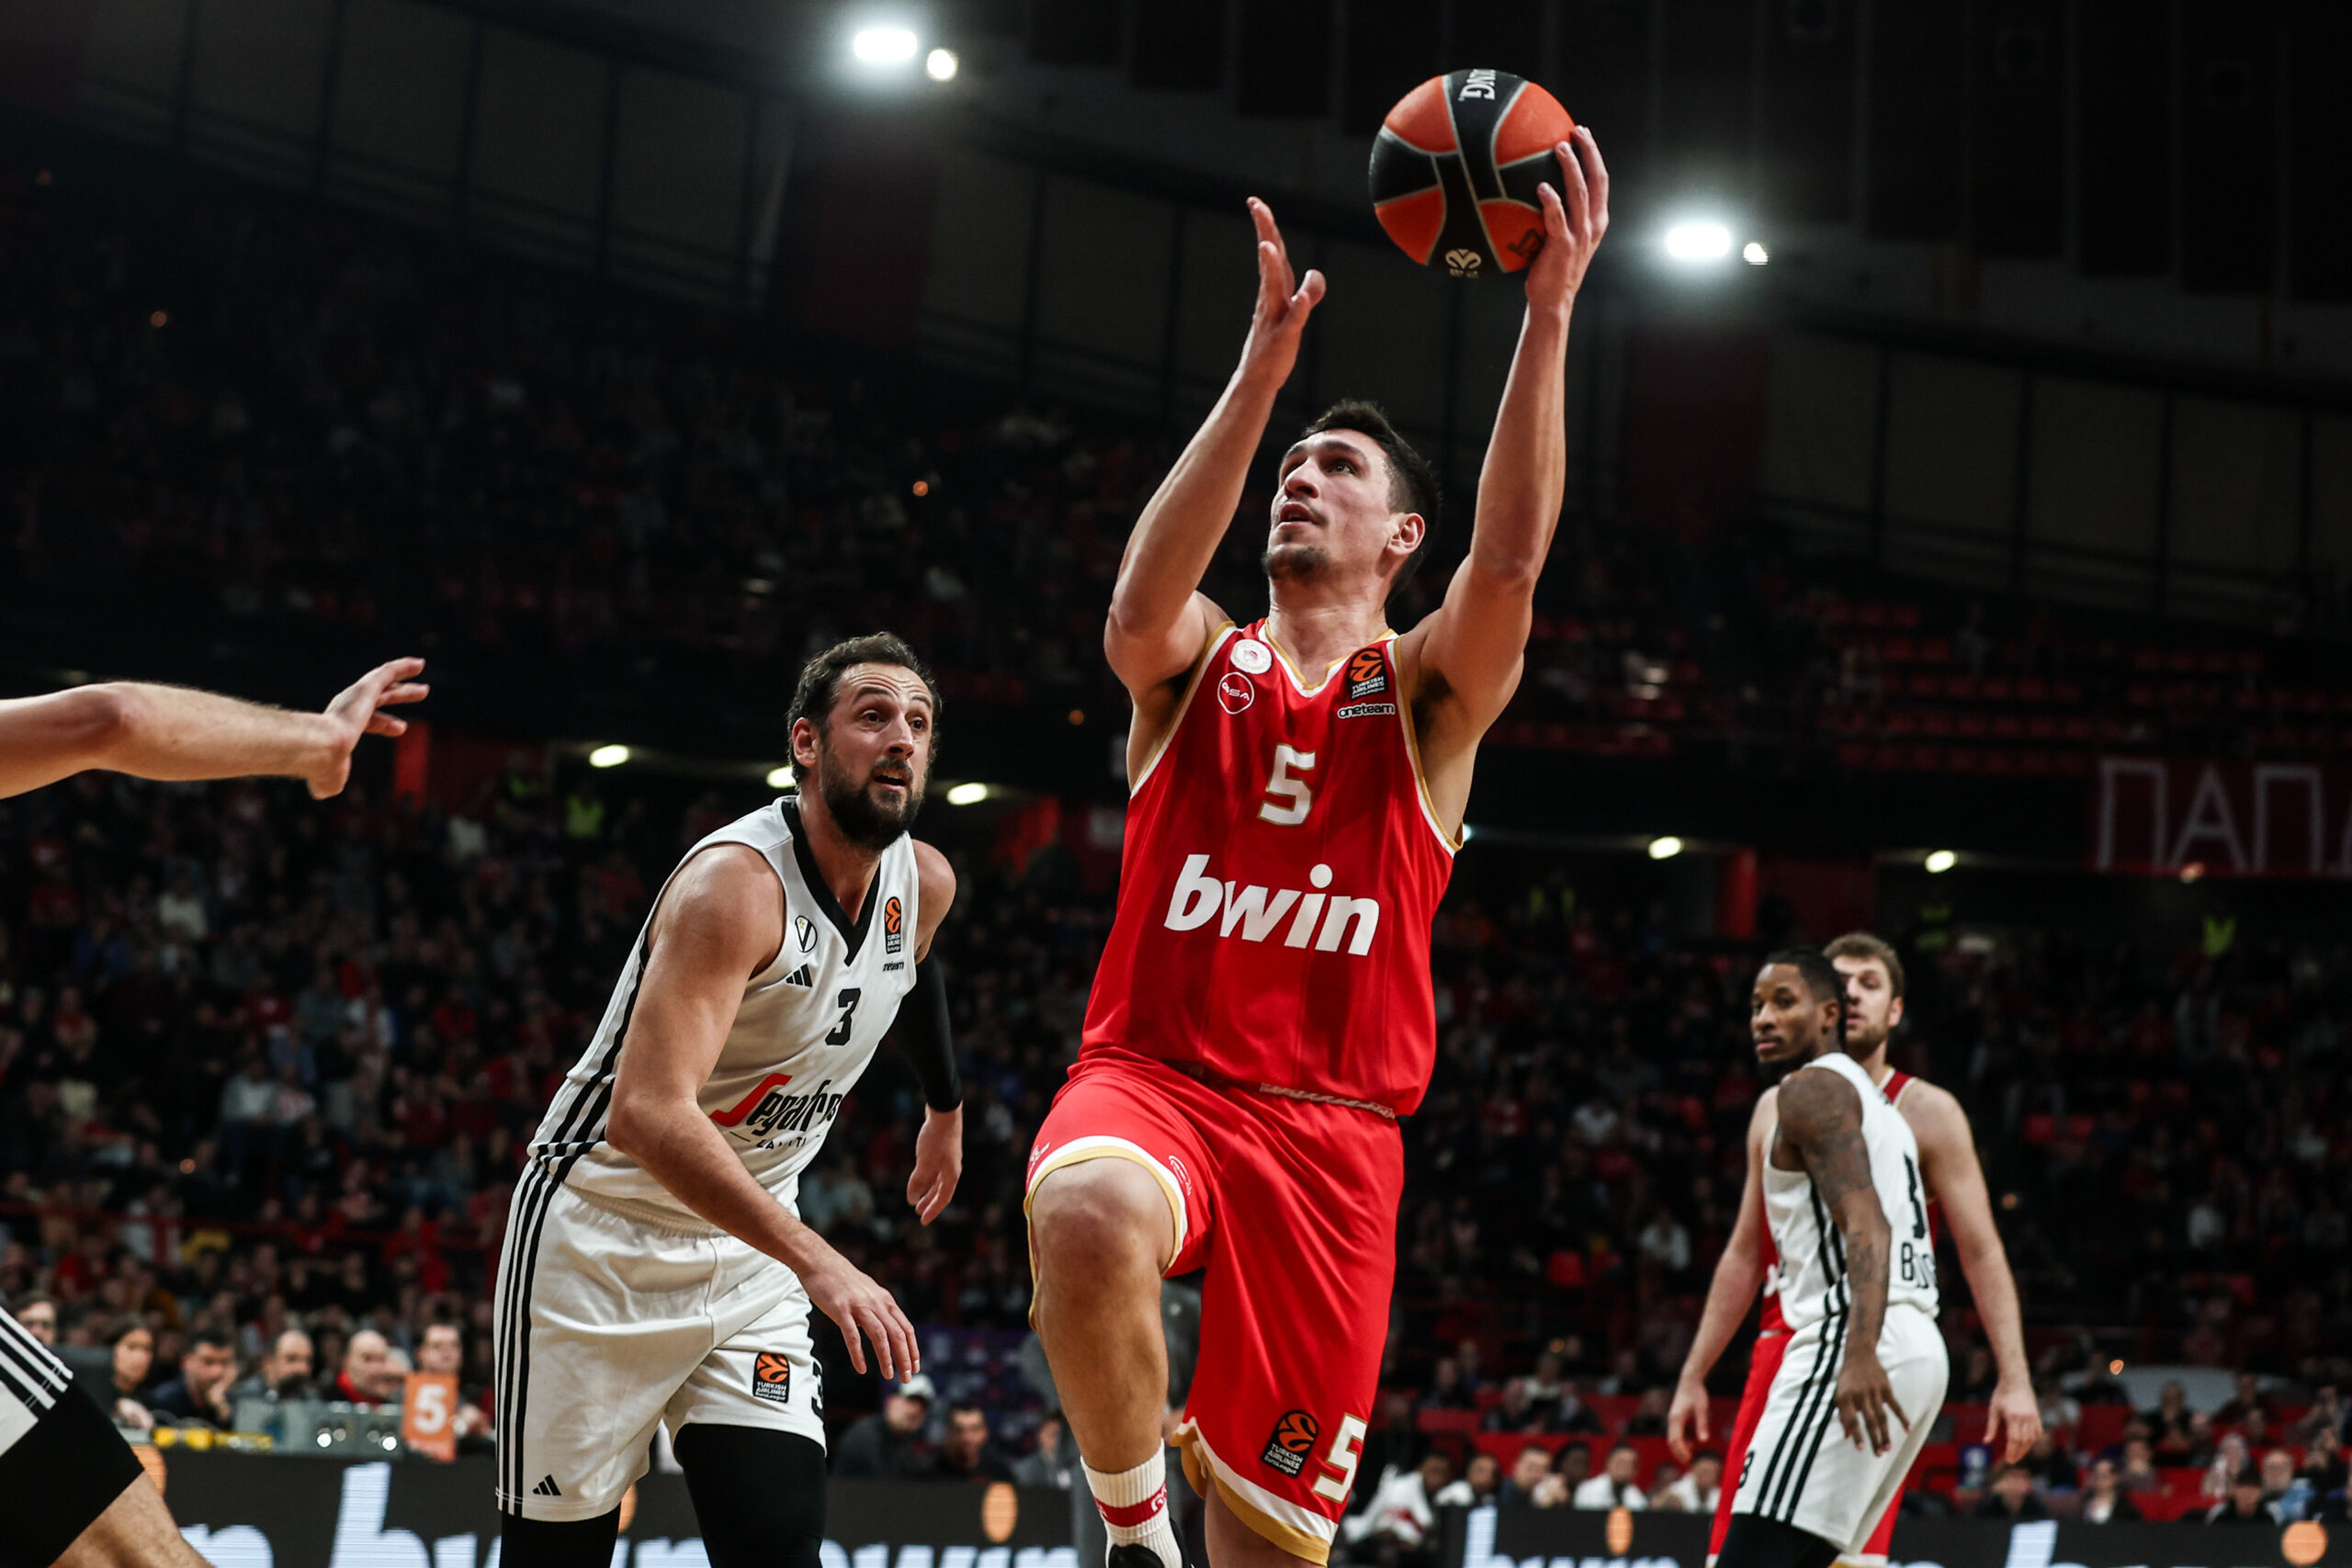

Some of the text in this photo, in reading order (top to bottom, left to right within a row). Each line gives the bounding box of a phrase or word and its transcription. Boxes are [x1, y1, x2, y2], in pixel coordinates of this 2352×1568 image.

[1257, 742, 1316, 826] 5
[2096, 755, 2352, 873] ΠΑΠ
[1163, 853, 1380, 956] bwin
[825, 987, 861, 1045] 3
[413, 1382, 447, 1436] 5
[756, 1386, 786, 1396] AIRLINES
[757, 1382, 786, 1391] TURKISH
[1267, 1450, 1300, 1470] AIRLINES
[1271, 1443, 1304, 1463] TURKISH
[1312, 1412, 1368, 1504] 5
